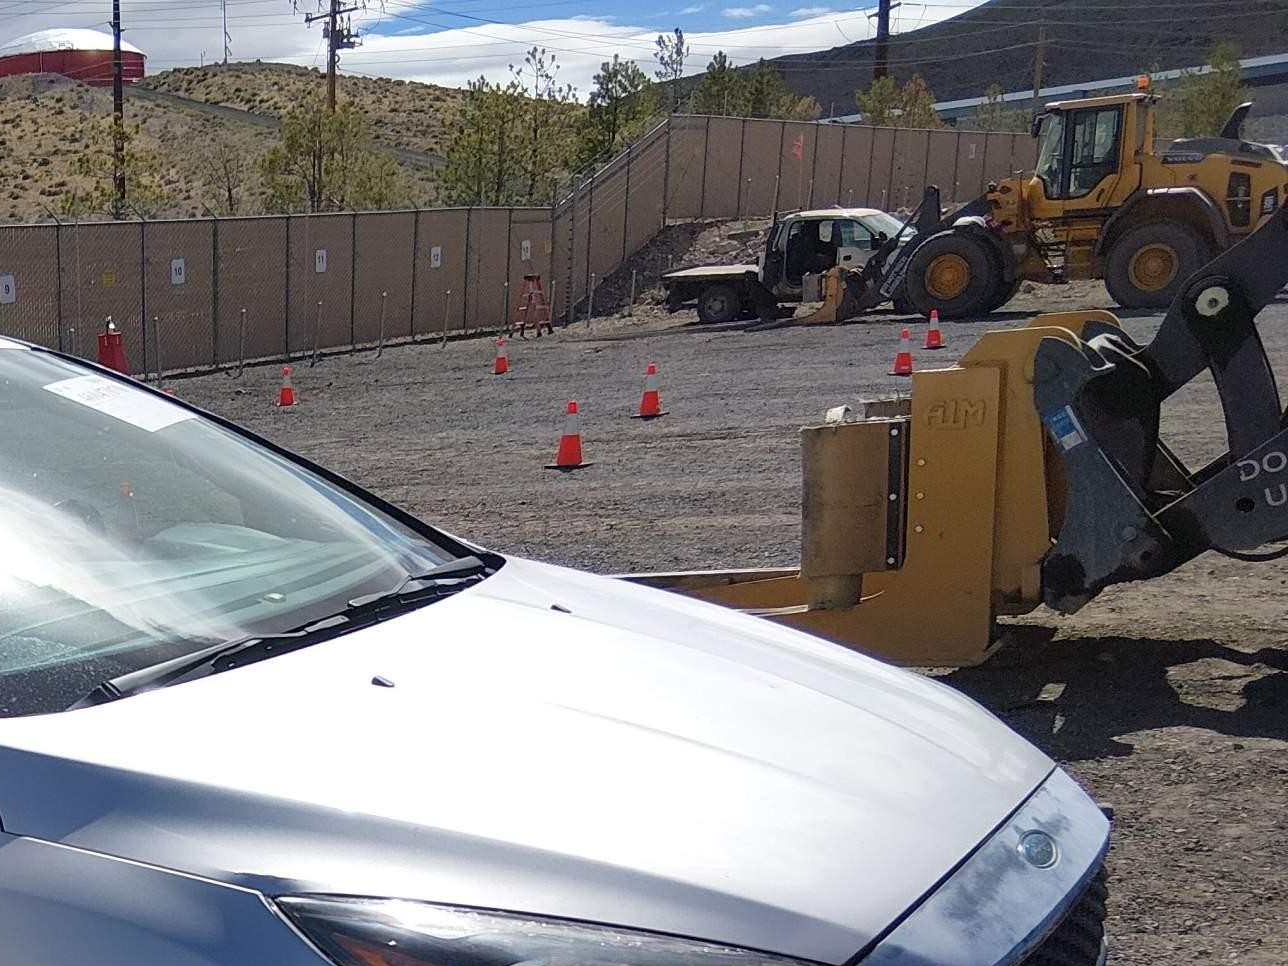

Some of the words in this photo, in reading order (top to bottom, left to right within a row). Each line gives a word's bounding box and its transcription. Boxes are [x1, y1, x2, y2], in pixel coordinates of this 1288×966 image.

[175, 266, 183, 276] 10
[4, 284, 10, 294] 9
[1236, 451, 1288, 481] DO
[1264, 483, 1288, 506] U
